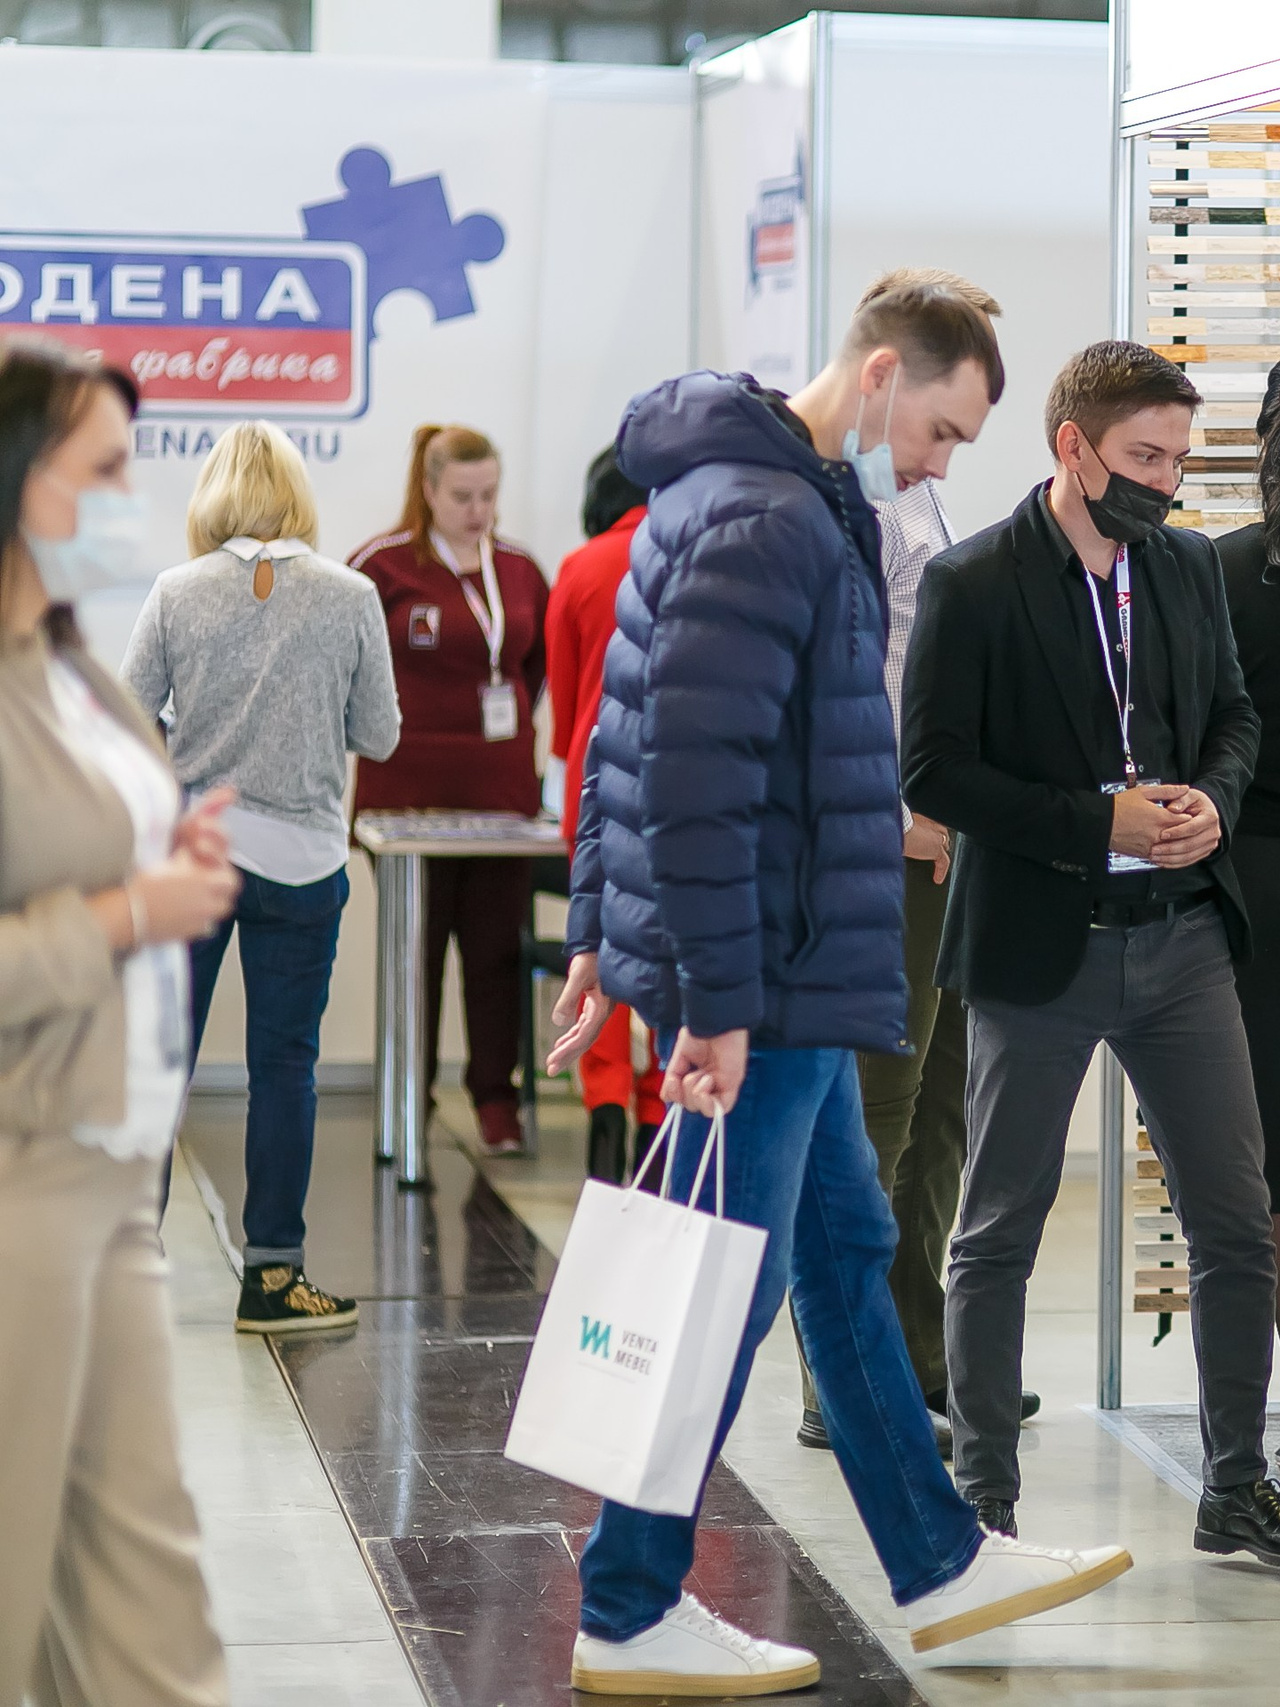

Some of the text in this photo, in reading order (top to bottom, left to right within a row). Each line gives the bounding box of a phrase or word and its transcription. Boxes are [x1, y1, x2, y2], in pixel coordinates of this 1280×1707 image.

[130, 337, 340, 392] фабрика
[622, 1330, 658, 1353] VENTA
[614, 1349, 651, 1376] MEBEL
